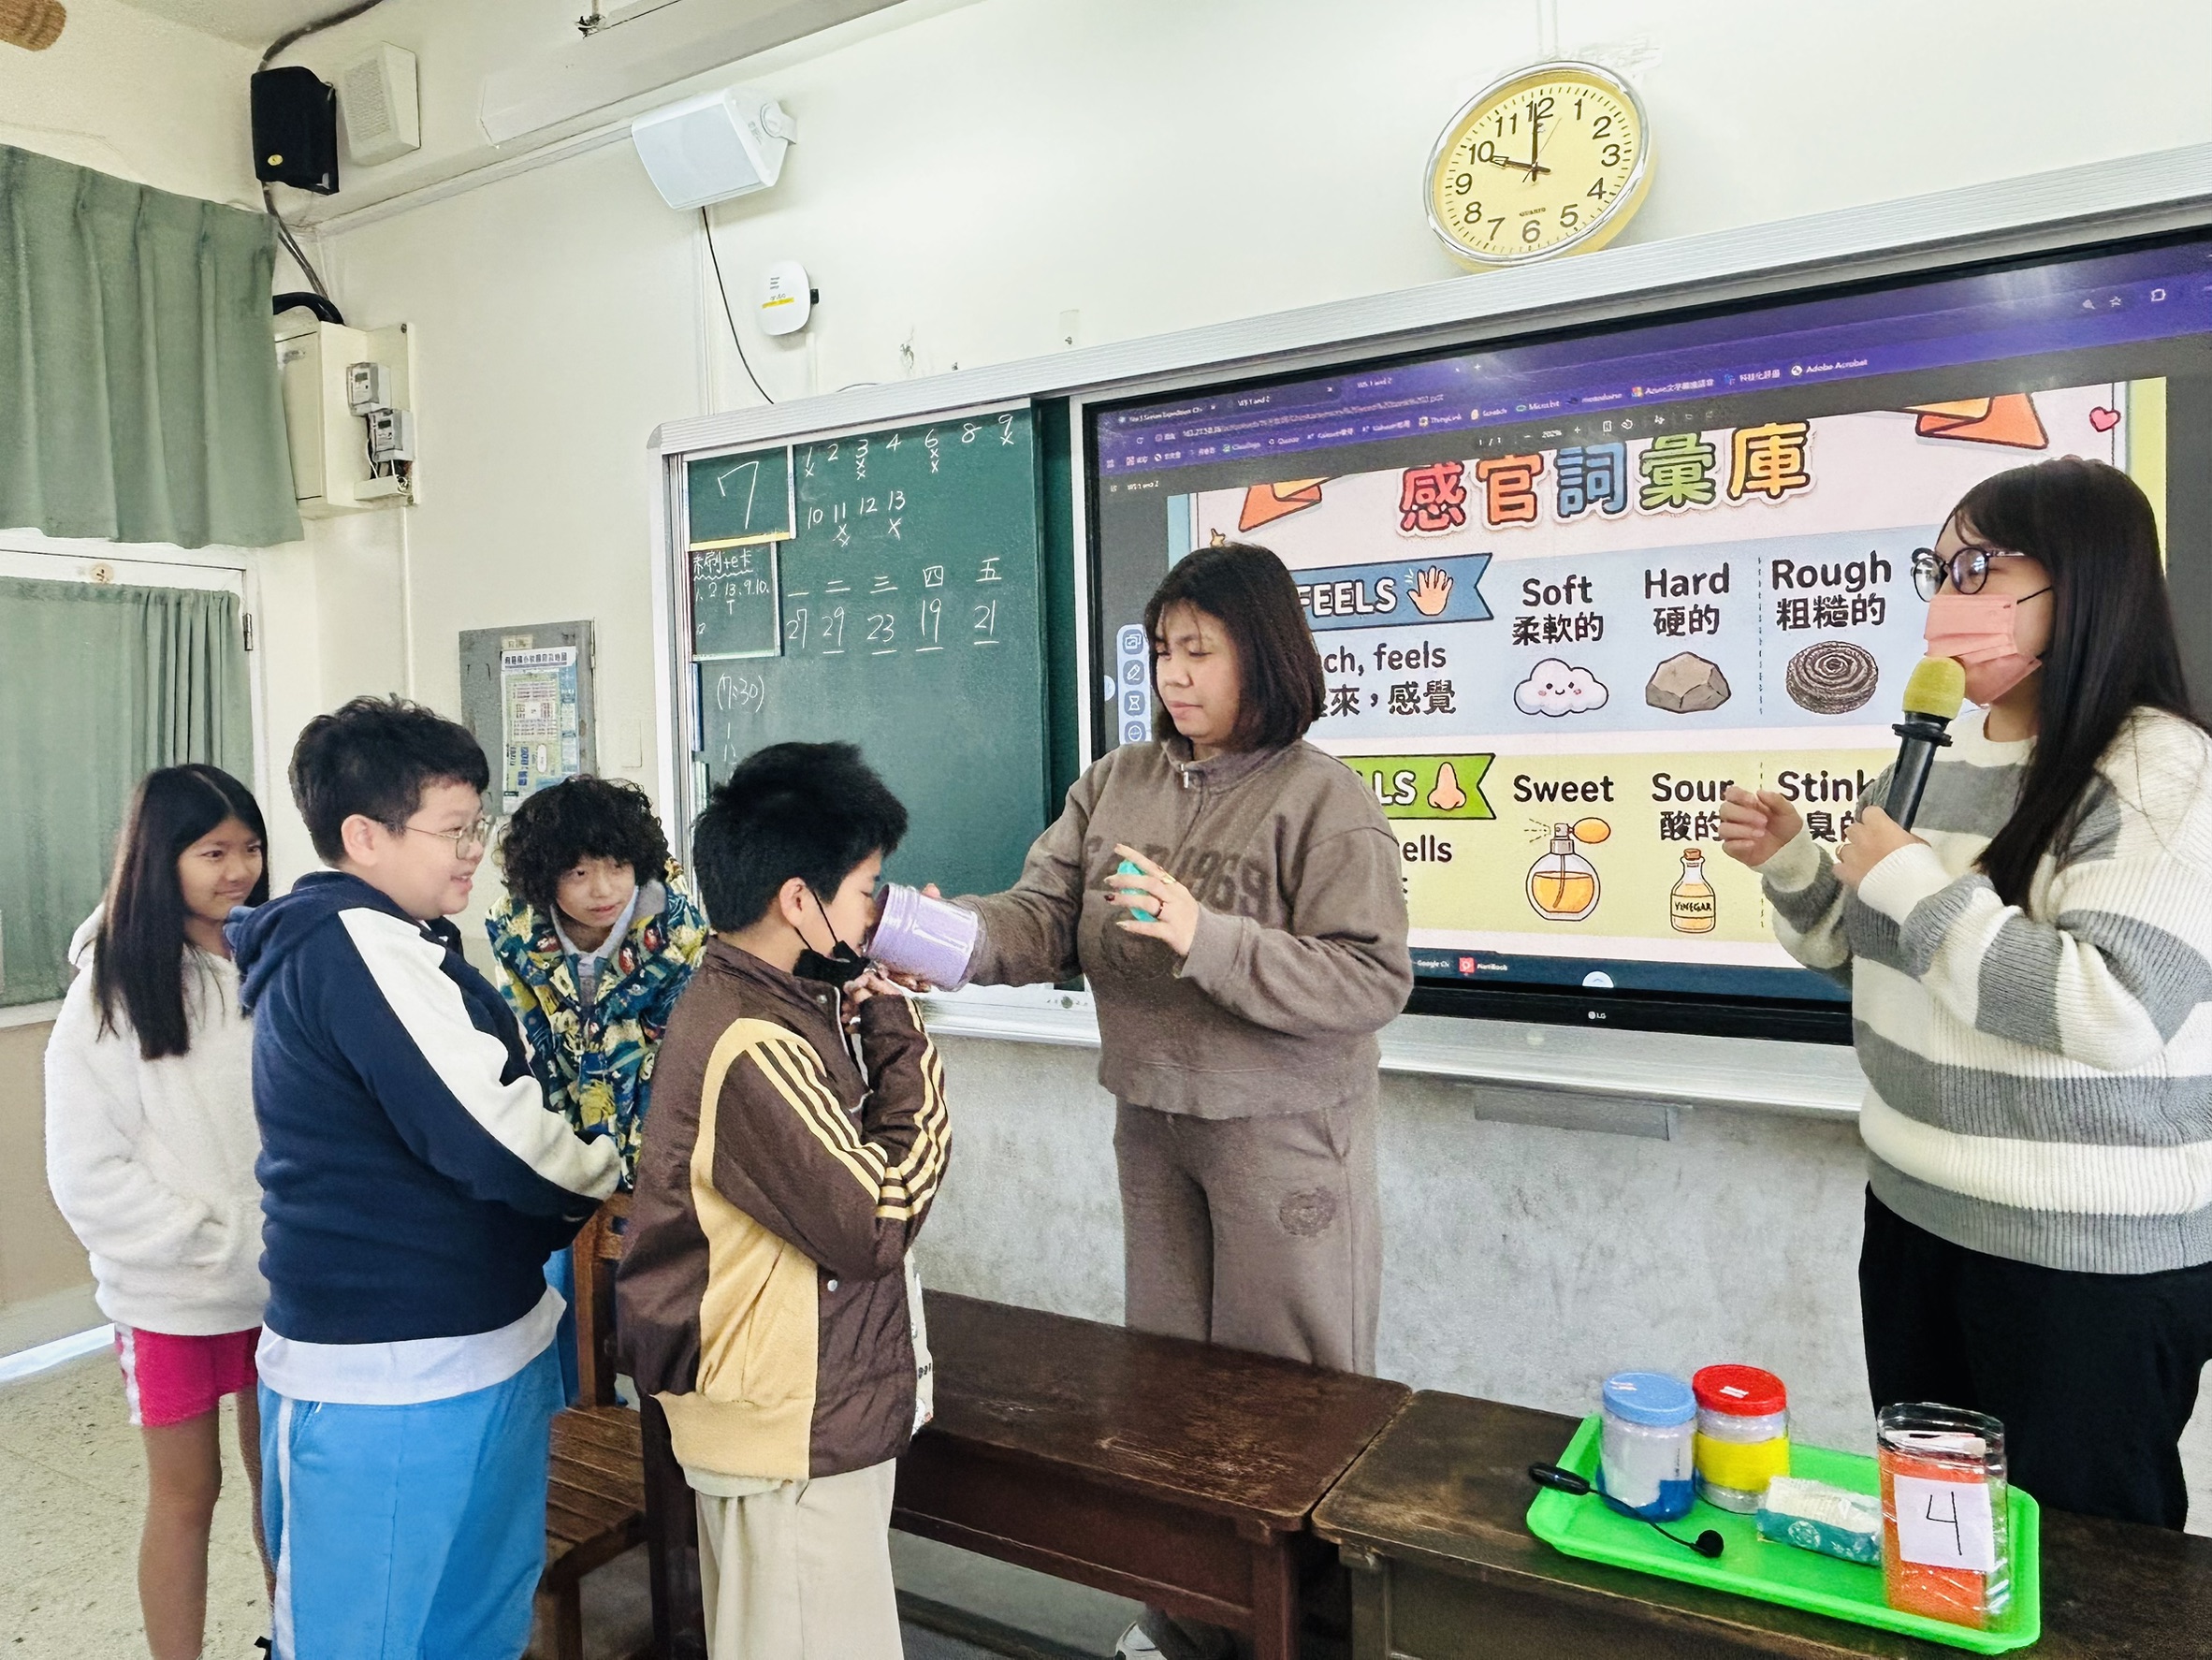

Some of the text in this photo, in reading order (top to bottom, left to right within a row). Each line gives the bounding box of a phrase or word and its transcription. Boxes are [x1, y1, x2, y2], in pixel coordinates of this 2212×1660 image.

[1526, 97, 1554, 122] 12
[1574, 98, 1583, 120] 1
[1495, 112, 1518, 138] 11
[1592, 115, 1612, 139] 2
[1468, 140, 1495, 165] 10
[1601, 143, 1621, 167] 3
[1455, 172, 1473, 195] 9
[1587, 177, 1607, 199] 4
[1463, 201, 1482, 224] 8
[1560, 203, 1579, 227] 5
[1487, 217, 1506, 240] 7
[1521, 219, 1541, 243] 6
[1806, 357, 1869, 374] Adobe Acrobat
[826, 443, 840, 461] 2
[855, 438, 869, 459] 3
[885, 433, 901, 451] 4
[924, 429, 939, 449] 6
[960, 422, 982, 444] 8
[998, 414, 1013, 436] 9
[1400, 421, 1812, 531] 感官詞彙庫
[717, 460, 760, 530] 7
[808, 490, 906, 531] 10 11 12 13
[923, 564, 944, 589] 四
[975, 557, 1002, 582] 五
[1644, 562, 1730, 600] Hard
[1771, 550, 1892, 593] Rough
[1522, 574, 1594, 607] Soft
[787, 598, 997, 649] 27 29 23 19 21
[1652, 604, 1721, 637] 硬的
[1776, 592, 1886, 632] 粗糙的
[1511, 611, 1604, 647] 柔軟的
[1323, 640, 1448, 677] ch, feels
[1319, 679, 1457, 718] 來，感覺
[1513, 774, 1615, 804] Sweet
[1652, 772, 1735, 803] Sour
[1778, 768, 1877, 803] Stink
[1402, 834, 1453, 863] ells
[1416, 960, 1440, 969] Google
[1926, 1490, 1963, 1556] 4
